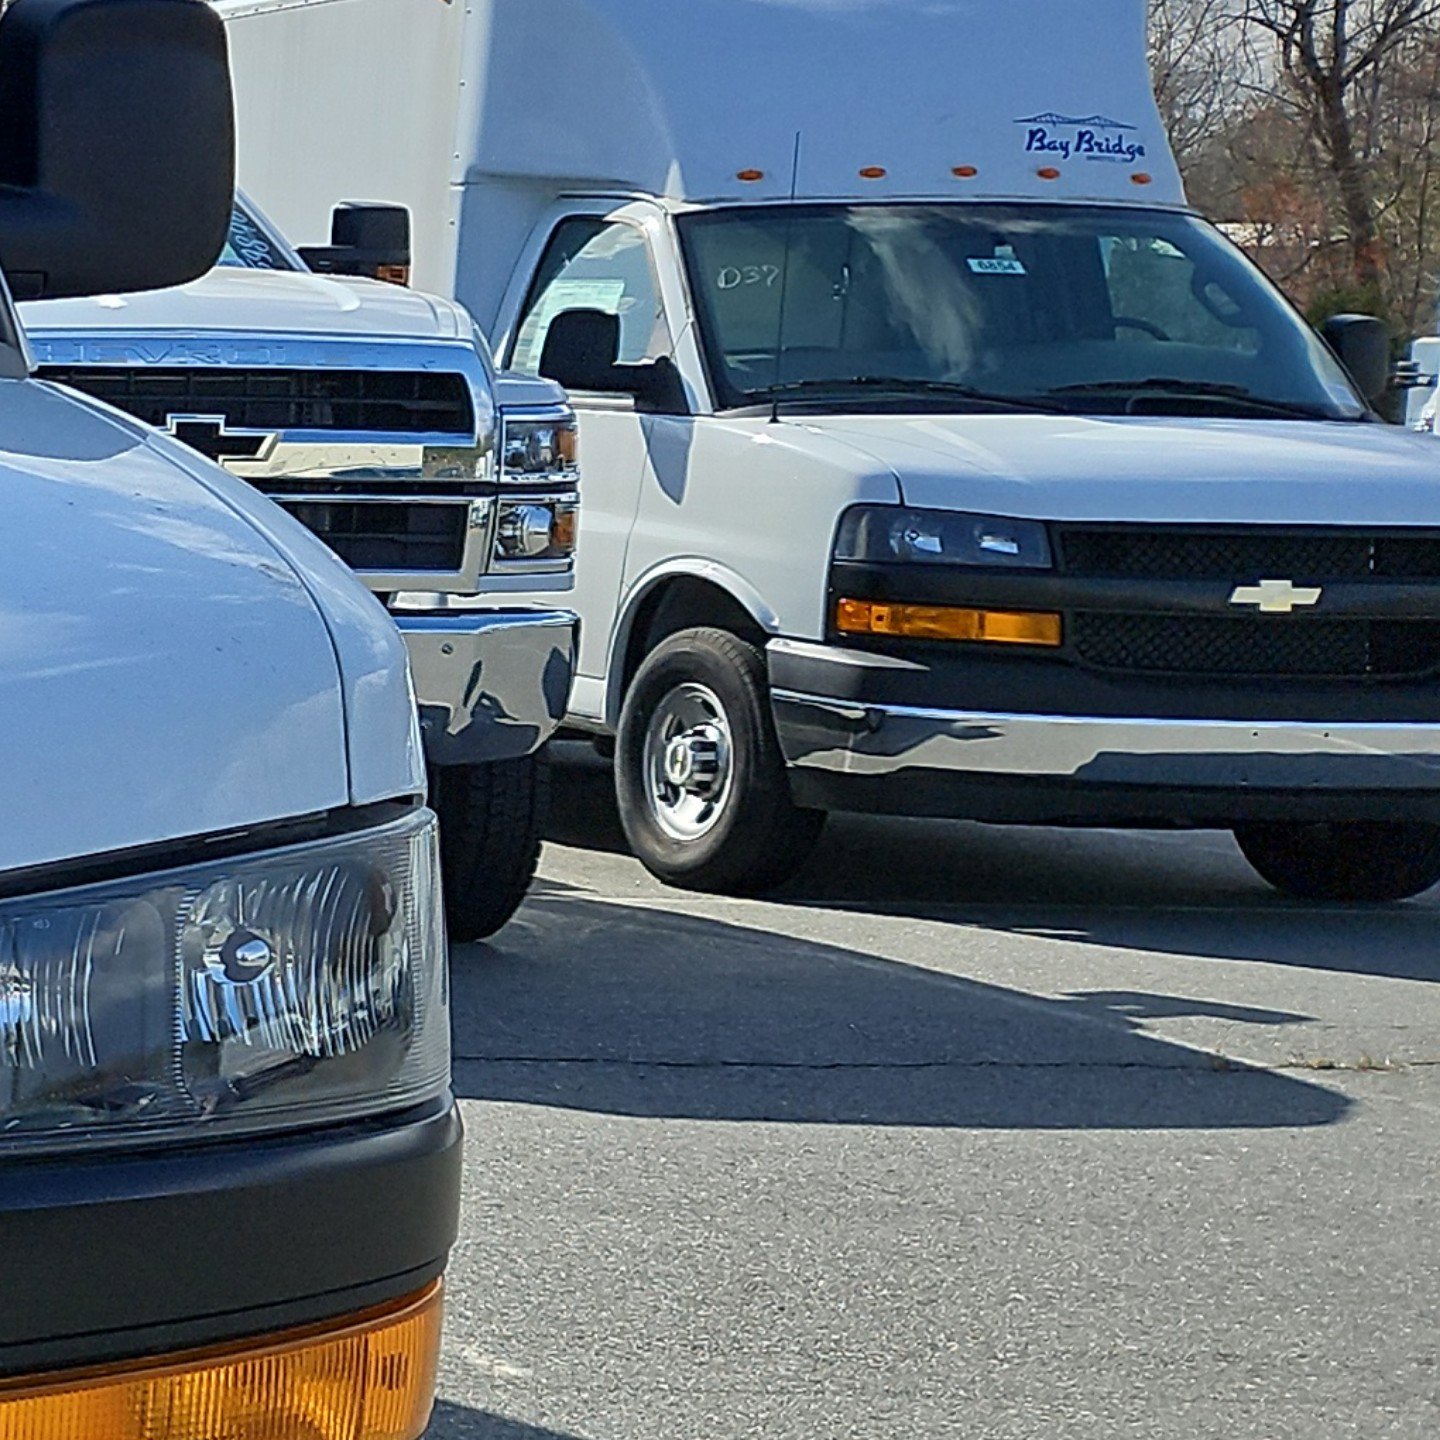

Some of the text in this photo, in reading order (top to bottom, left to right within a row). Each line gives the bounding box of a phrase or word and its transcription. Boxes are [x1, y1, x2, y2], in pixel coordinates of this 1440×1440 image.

[1025, 129, 1146, 163] Bay Bridge
[717, 264, 780, 289] D37
